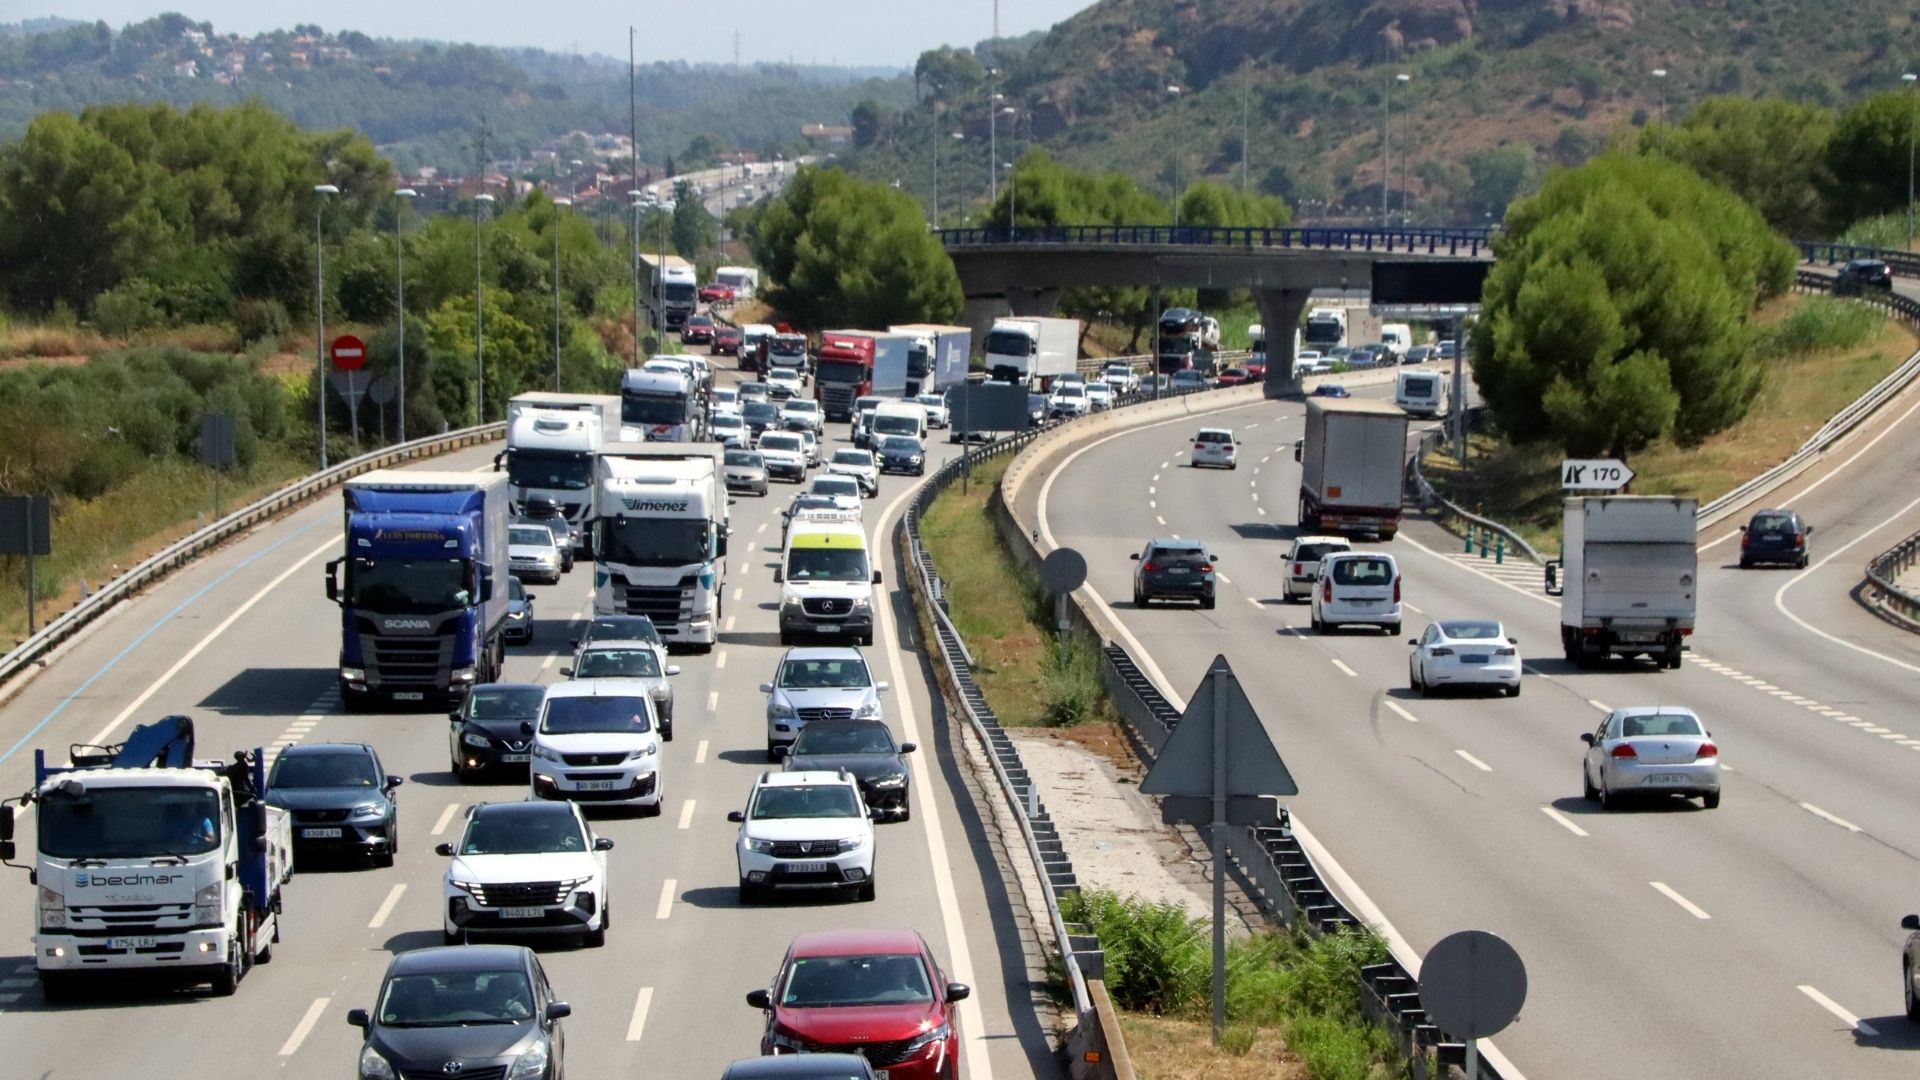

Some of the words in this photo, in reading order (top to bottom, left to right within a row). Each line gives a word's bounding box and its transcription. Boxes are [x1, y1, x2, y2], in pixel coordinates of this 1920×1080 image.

[1593, 468, 1620, 481] 170
[625, 499, 688, 511] Jimenez
[384, 619, 431, 629] SCANIA
[91, 874, 184, 886] bedmar
[115, 940, 135, 948] 1754
[138, 939, 155, 948] LRJ
